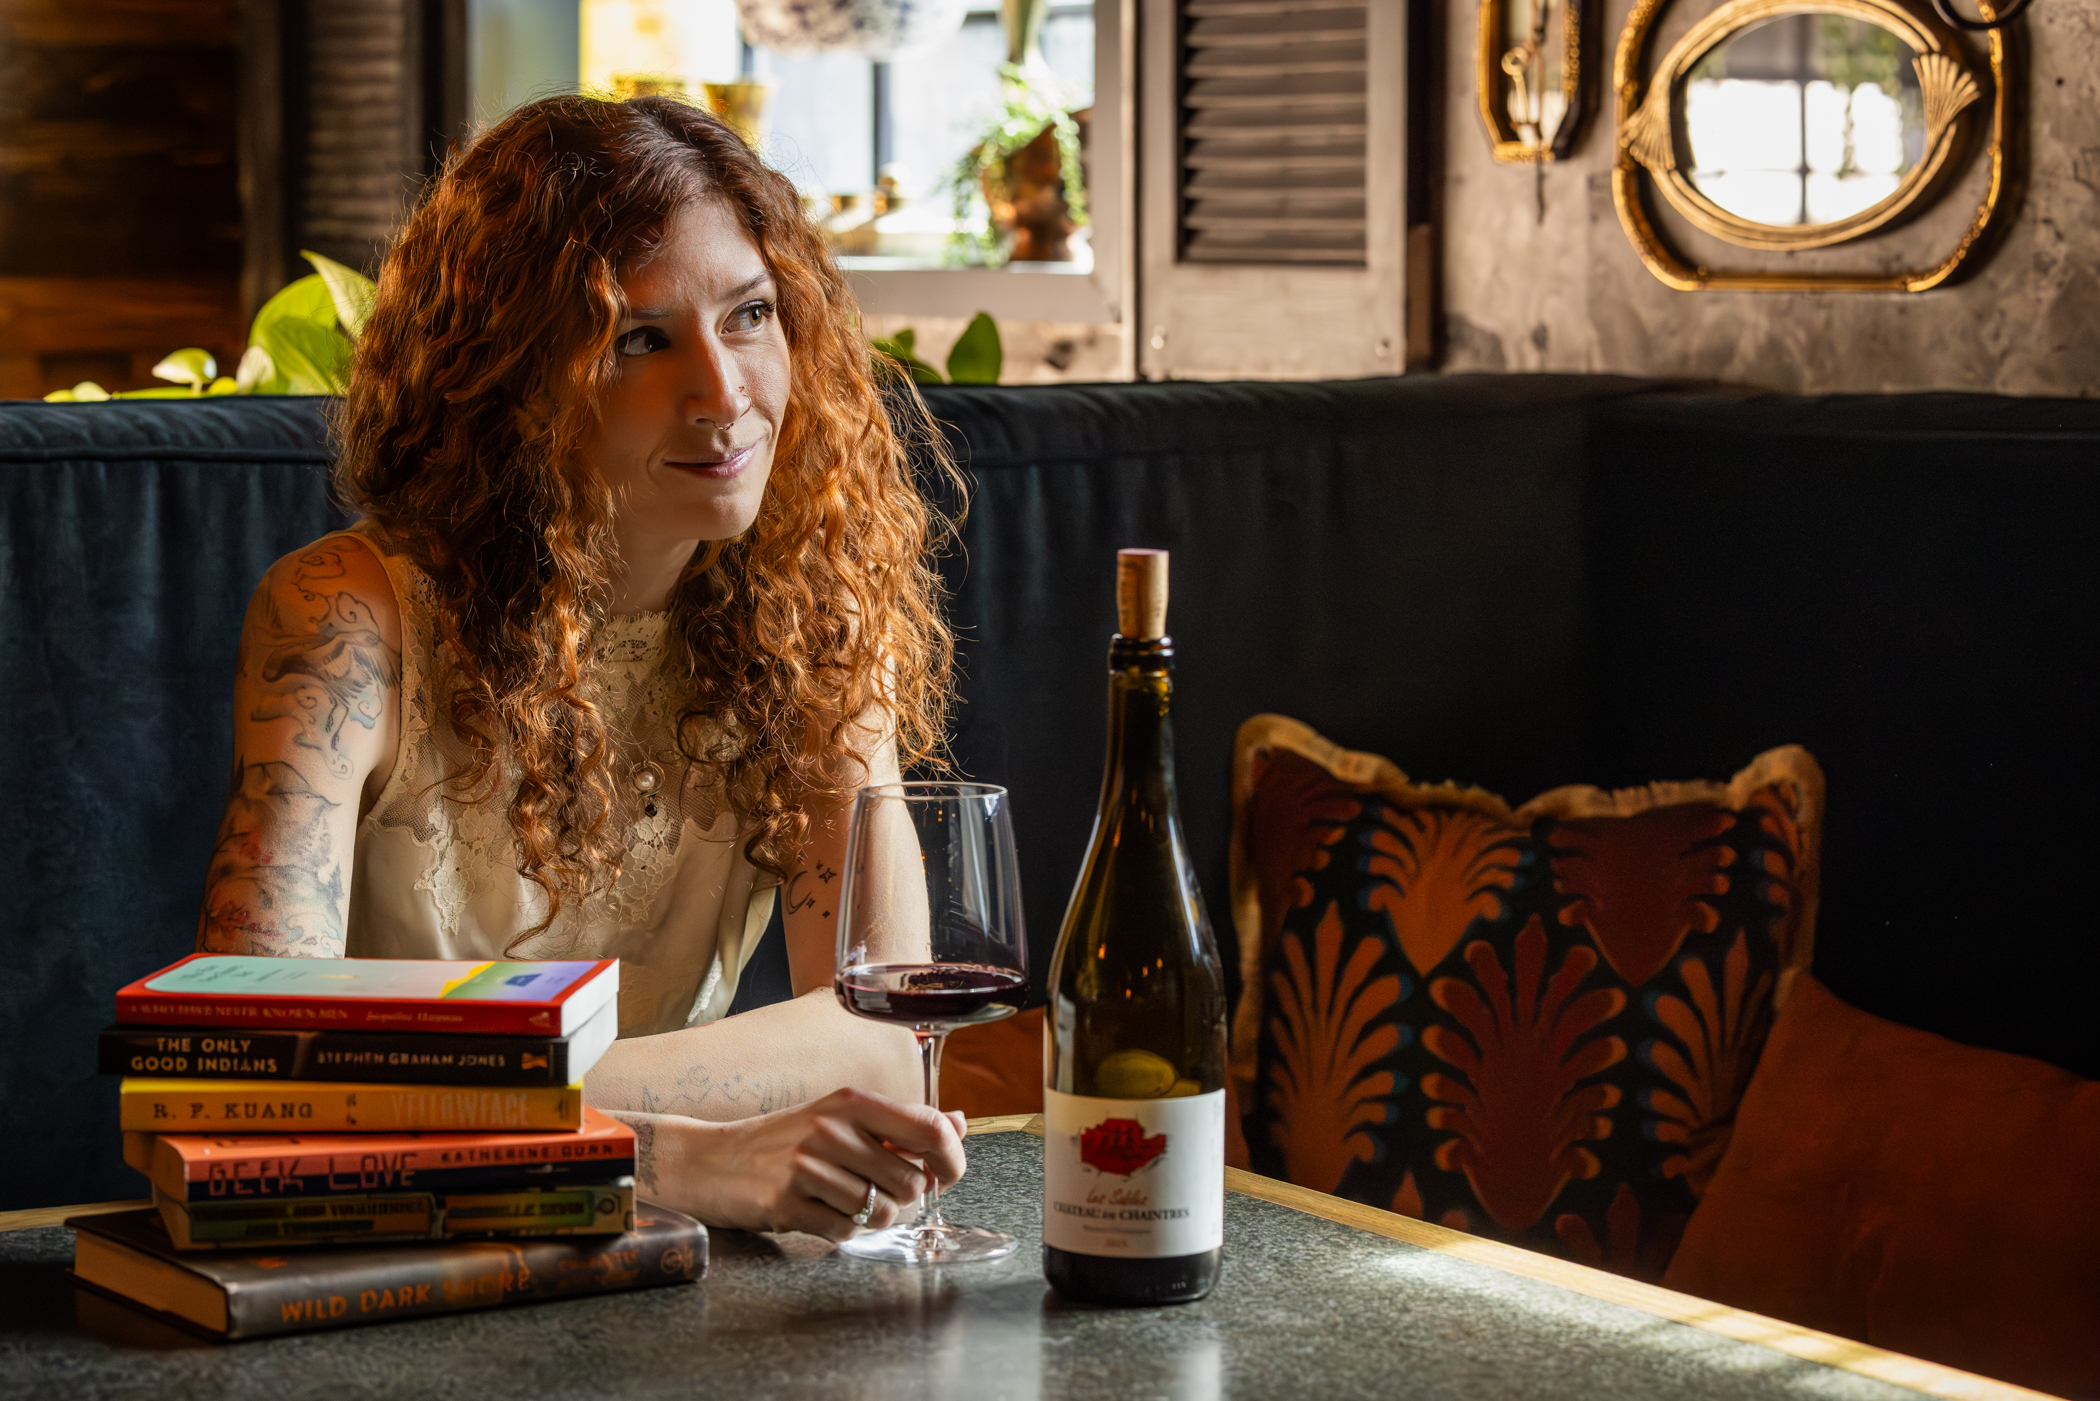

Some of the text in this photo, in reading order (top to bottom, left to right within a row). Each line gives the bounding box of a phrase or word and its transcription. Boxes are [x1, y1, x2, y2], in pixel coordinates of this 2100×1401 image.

[157, 1037, 251, 1053] THE ONLY
[131, 1056, 278, 1073] GOOD INDIANS
[317, 1051, 506, 1067] STEPHEN GRAHAM JONES
[153, 1103, 177, 1119] R.
[224, 1102, 313, 1119] KUANG
[392, 1093, 529, 1126] YELLOWFACE
[441, 1143, 613, 1163] KATHERINE DUNN
[208, 1152, 418, 1197] GEEK LOVE
[281, 1295, 348, 1323] WILD
[360, 1284, 431, 1312] DARK
[442, 1268, 531, 1300] SHORE
